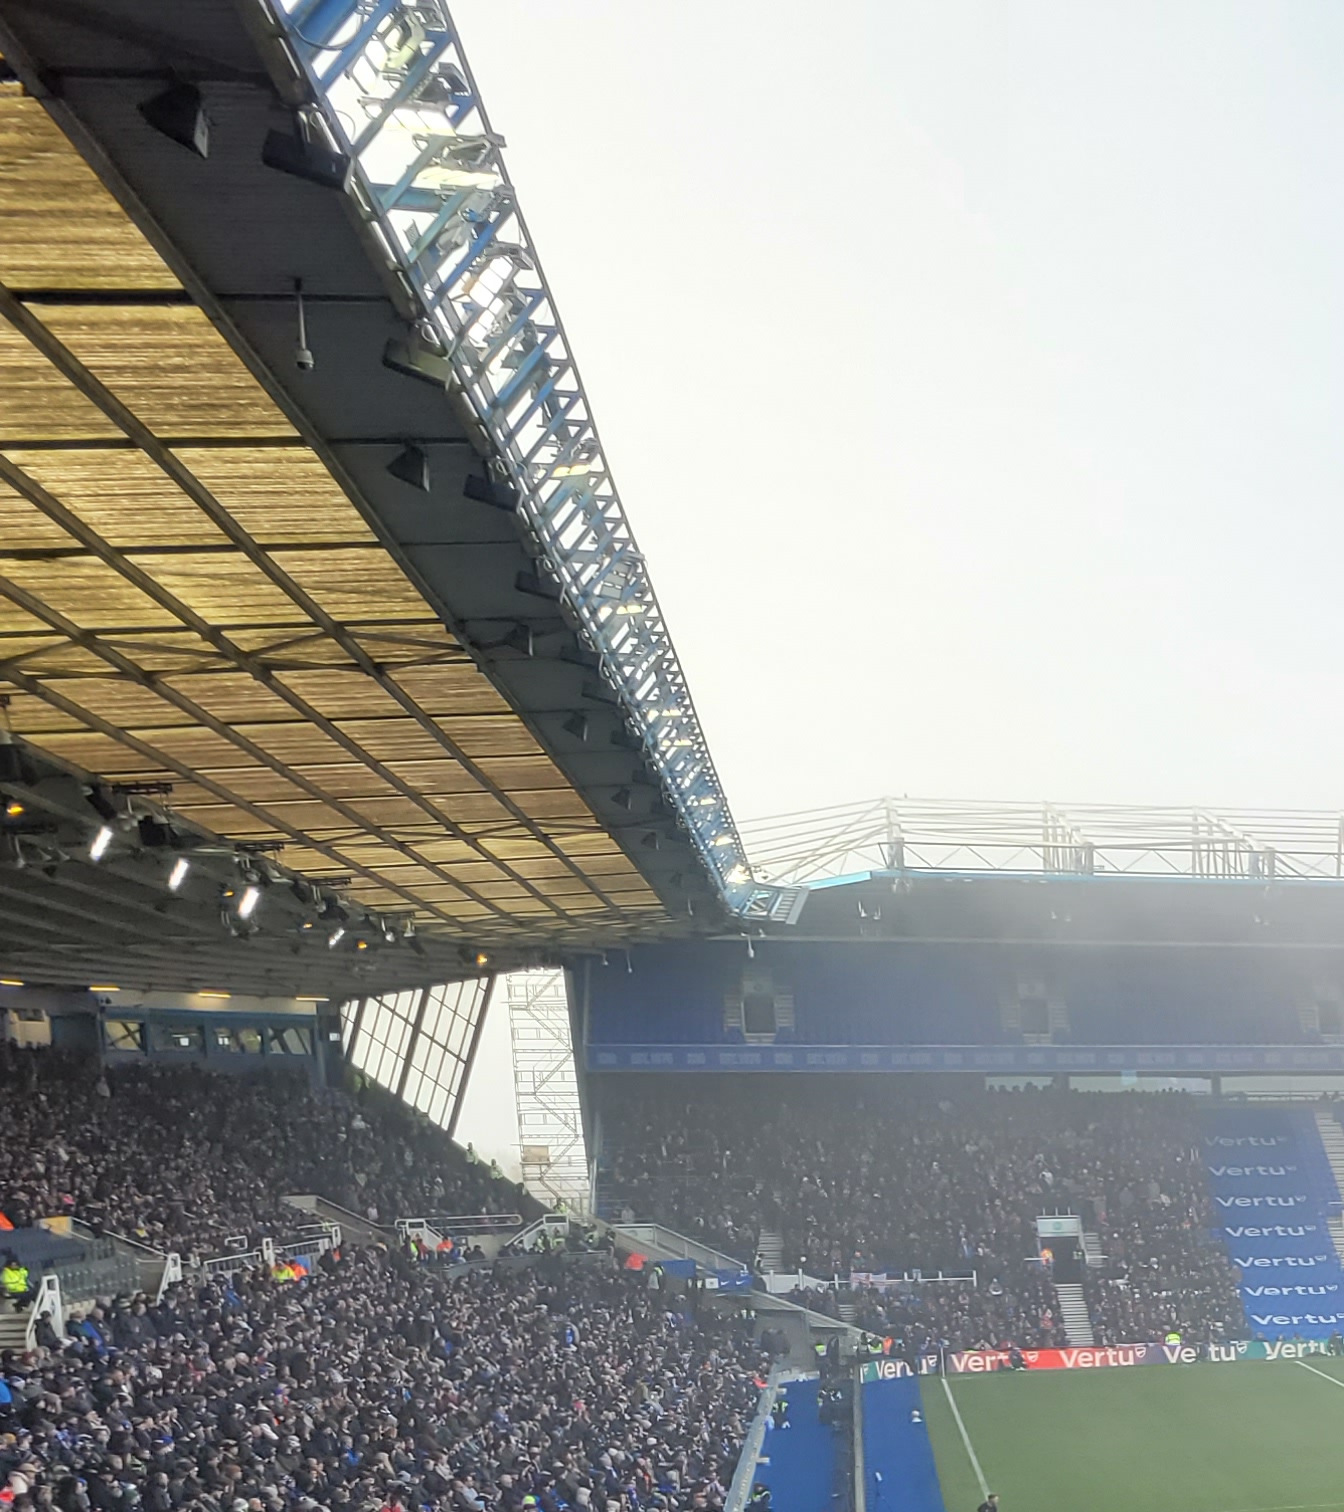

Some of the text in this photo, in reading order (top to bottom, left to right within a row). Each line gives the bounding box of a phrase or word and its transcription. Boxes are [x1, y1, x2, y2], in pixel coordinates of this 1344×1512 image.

[1208, 1165, 1286, 1176] Vertu
[1215, 1196, 1295, 1207] Vertu
[1225, 1225, 1305, 1237] Vertu
[1234, 1256, 1316, 1268] Vertu
[1244, 1285, 1327, 1297] Vertu
[1251, 1313, 1337, 1325] Vertu
[1059, 1348, 1134, 1369] Vertu
[1162, 1342, 1237, 1363] Vetu
